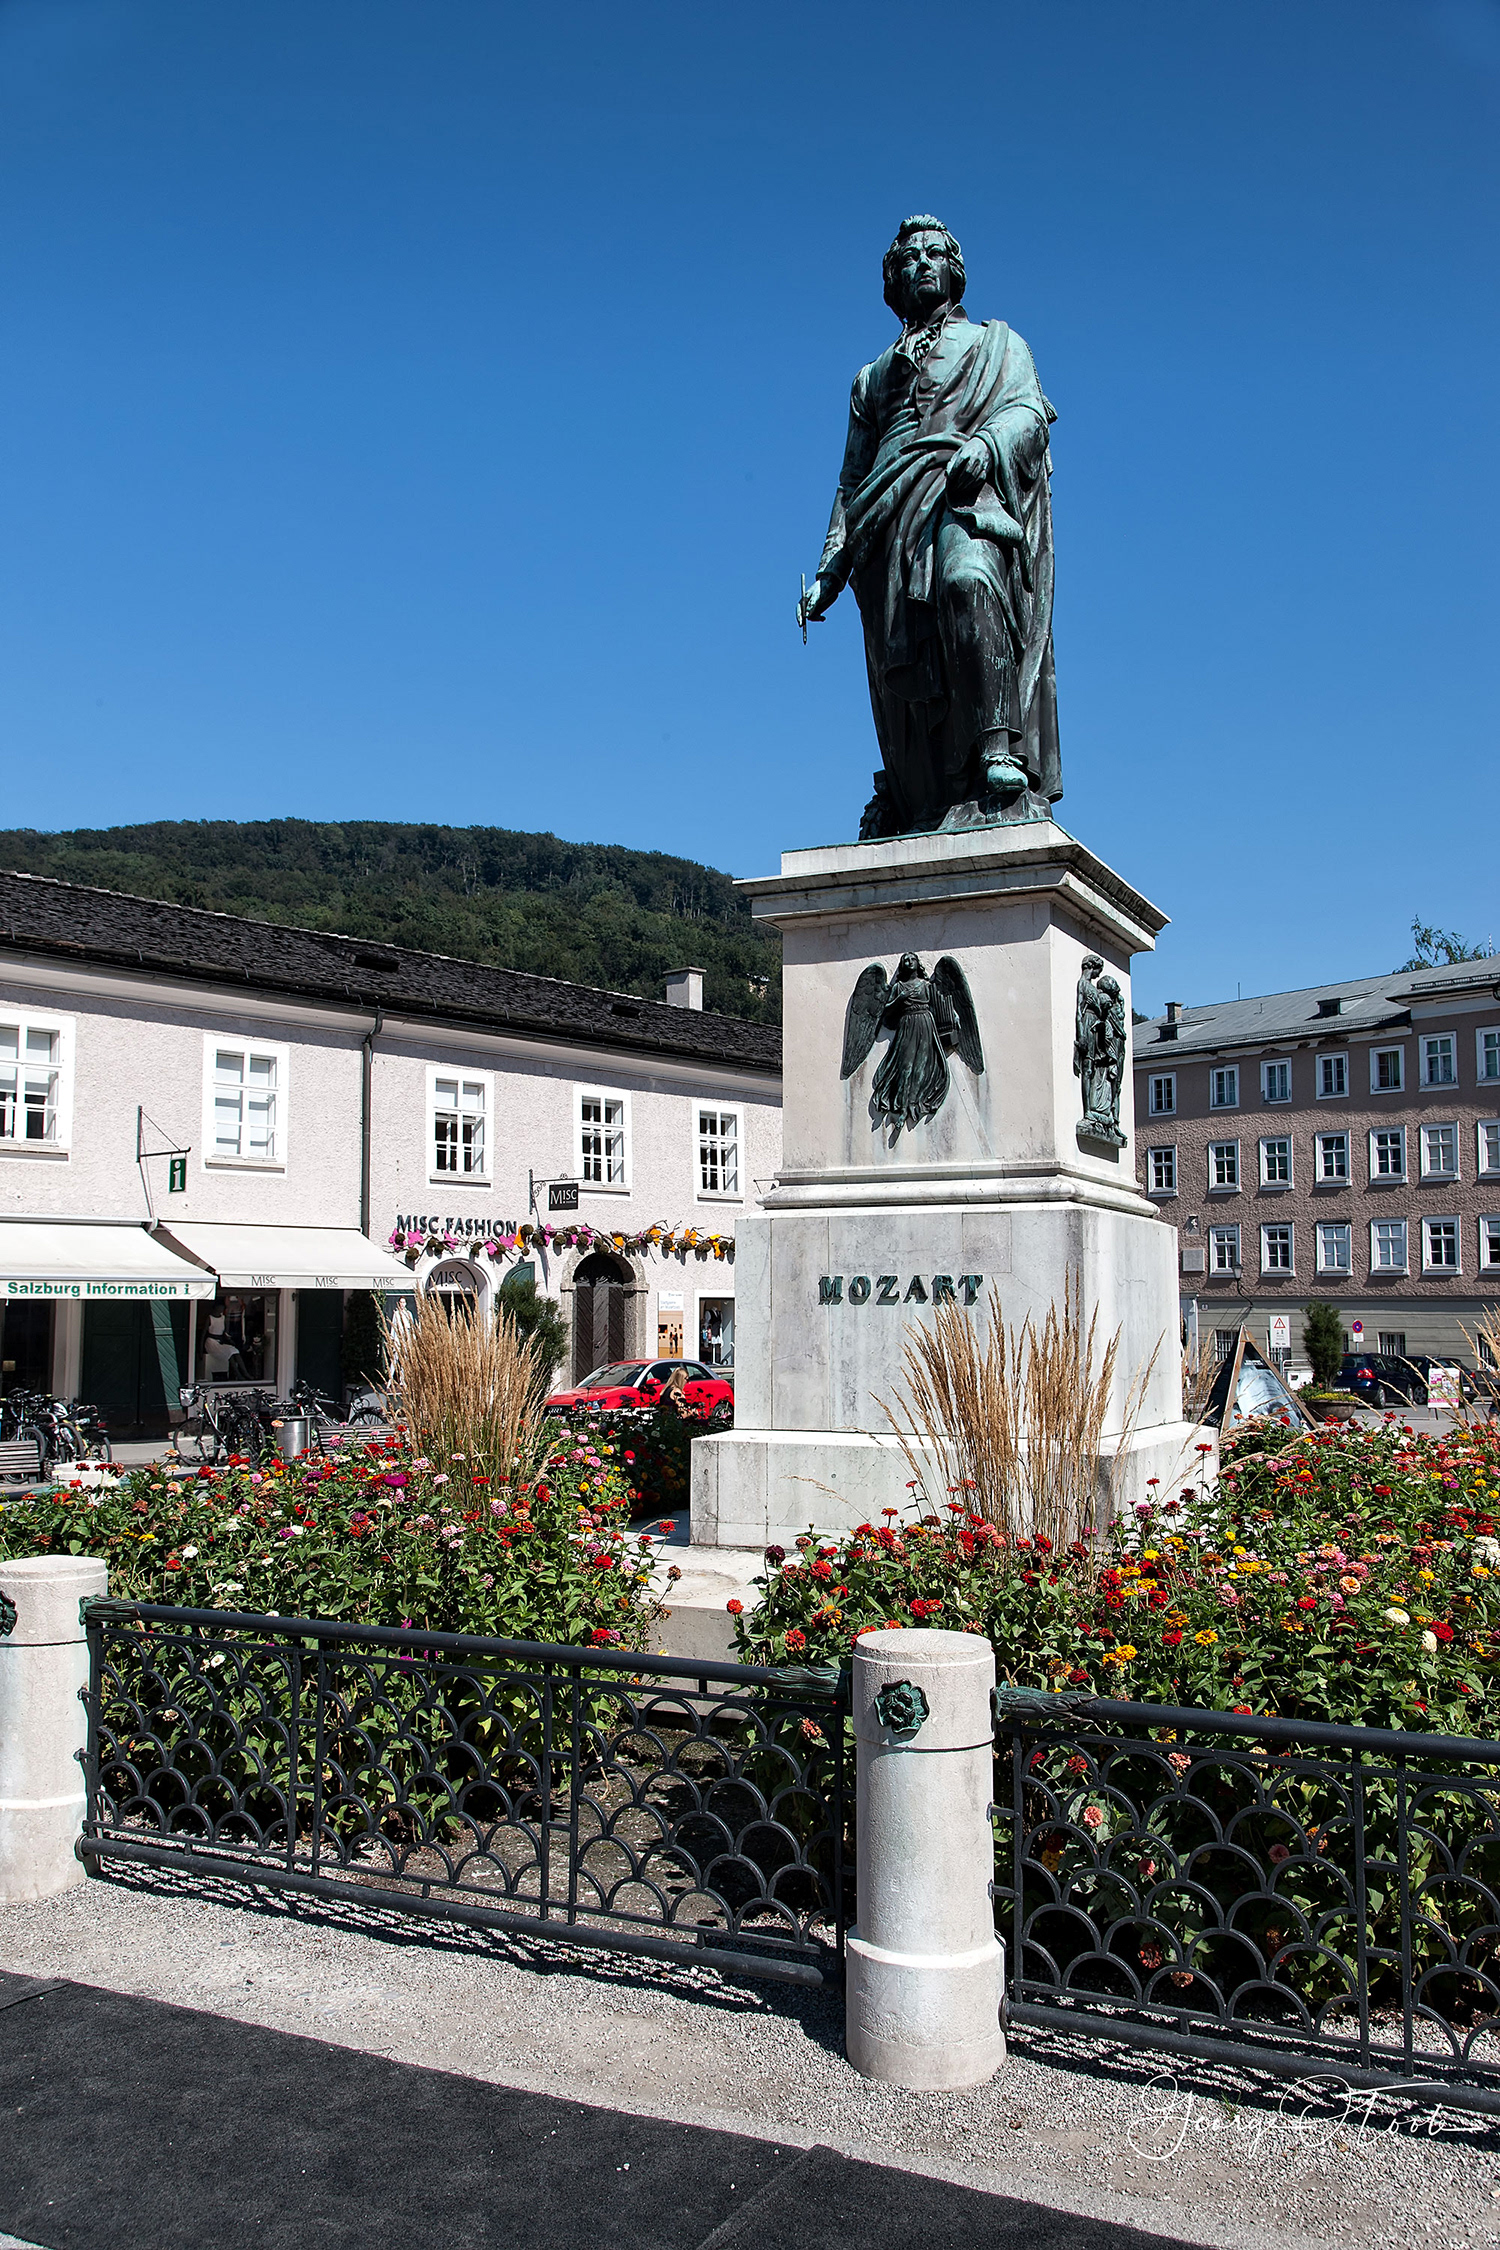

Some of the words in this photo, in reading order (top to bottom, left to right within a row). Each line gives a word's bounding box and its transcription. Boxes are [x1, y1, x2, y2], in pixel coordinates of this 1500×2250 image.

[173, 1161, 182, 1190] i
[8, 1281, 80, 1297] Salzburg
[87, 1282, 177, 1295] Information
[818, 1274, 983, 1305] MOZART
